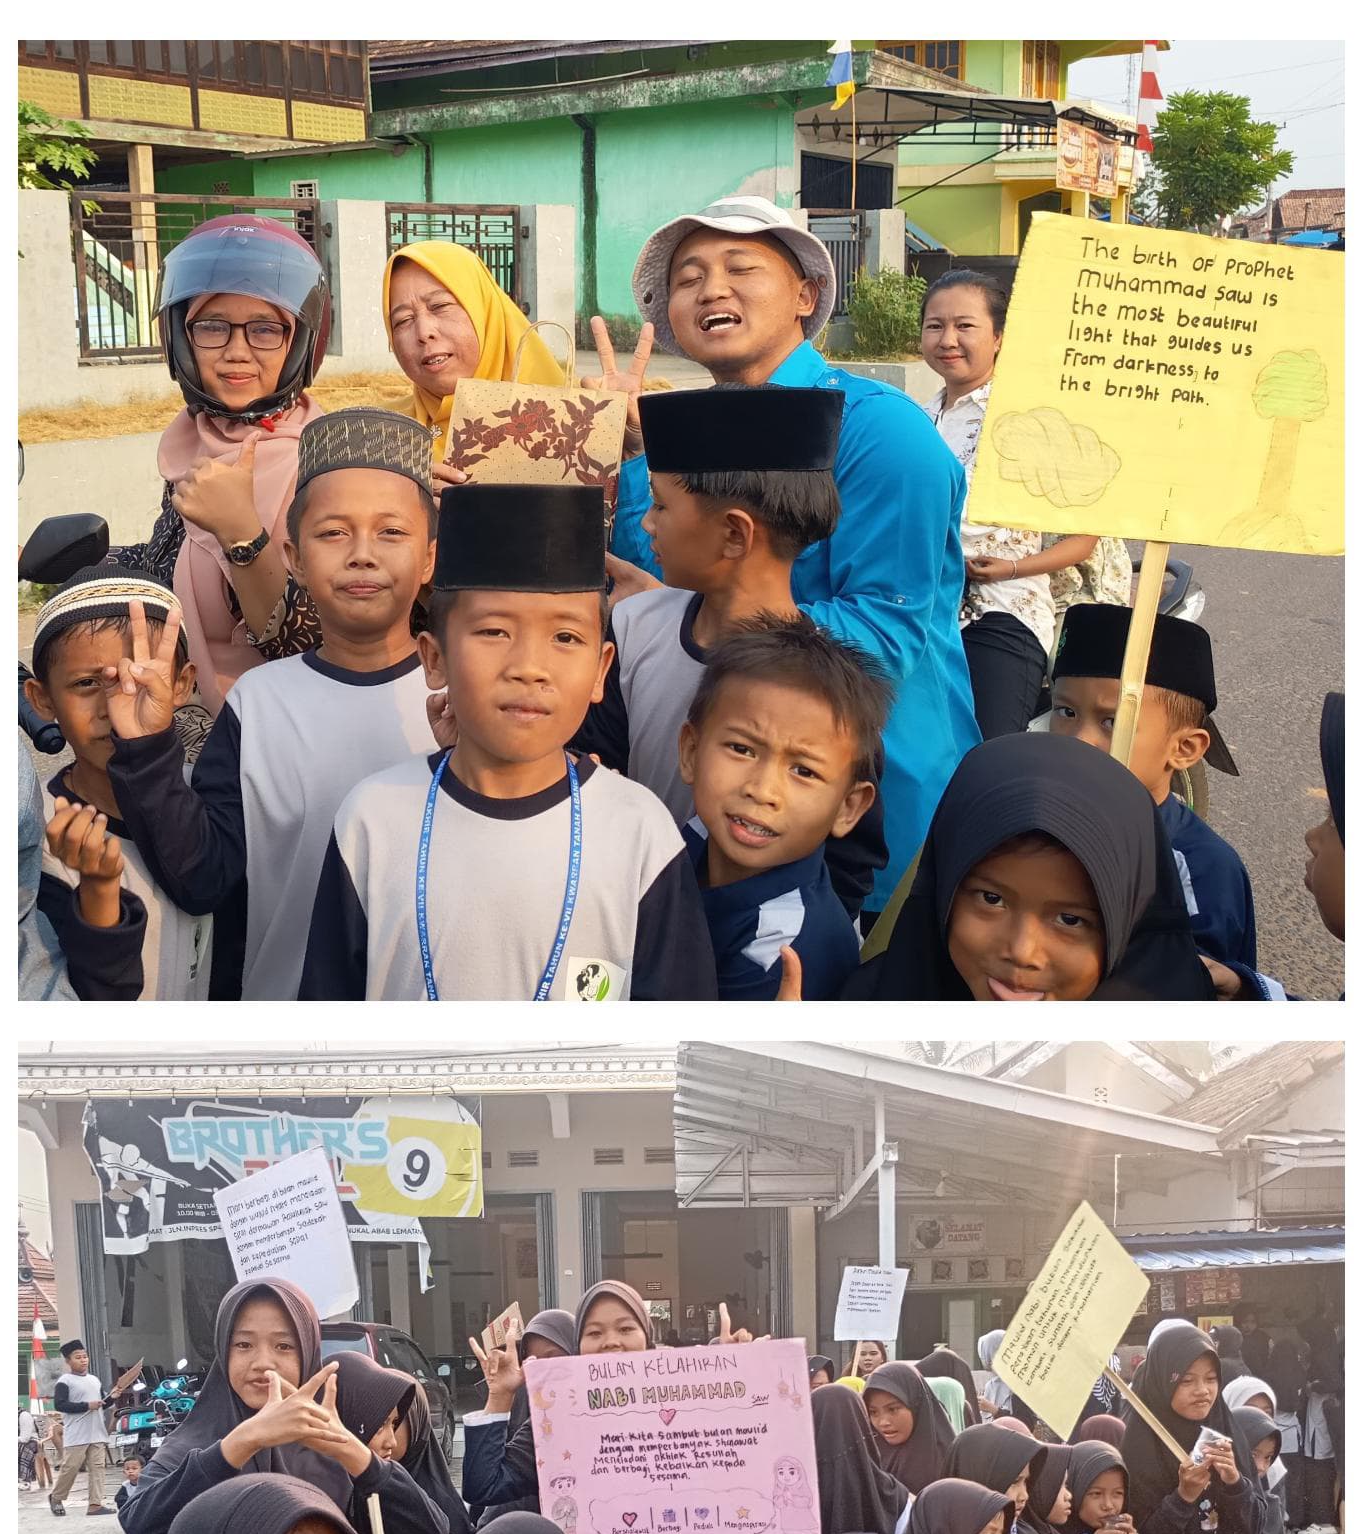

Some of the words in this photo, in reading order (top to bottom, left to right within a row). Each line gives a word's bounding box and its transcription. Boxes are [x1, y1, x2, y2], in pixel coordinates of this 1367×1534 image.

[1081, 236, 1120, 261] The
[1133, 244, 1178, 268] birth
[1072, 293, 1107, 317] the
[1117, 304, 1165, 323] most
[1068, 320, 1113, 345] light
[1123, 331, 1157, 348] that
[1232, 342, 1253, 357] us
[1060, 374, 1091, 392] the
[1105, 374, 1160, 402] bright
[1204, 366, 1220, 381] to
[546, 943, 563, 979] TAHUN
[165, 1118, 385, 1169] BROTHER'S
[403, 1148, 430, 1187] 9
[945, 1223, 984, 1232] SELAMAT
[948, 1233, 980, 1242] DATANG
[588, 1360, 635, 1382] BULAN
[644, 1352, 738, 1377] KELAHIRAN
[587, 1387, 636, 1410] NABI
[641, 1380, 747, 1404] MUHAMMAD
[590, 1465, 609, 1475] dan
